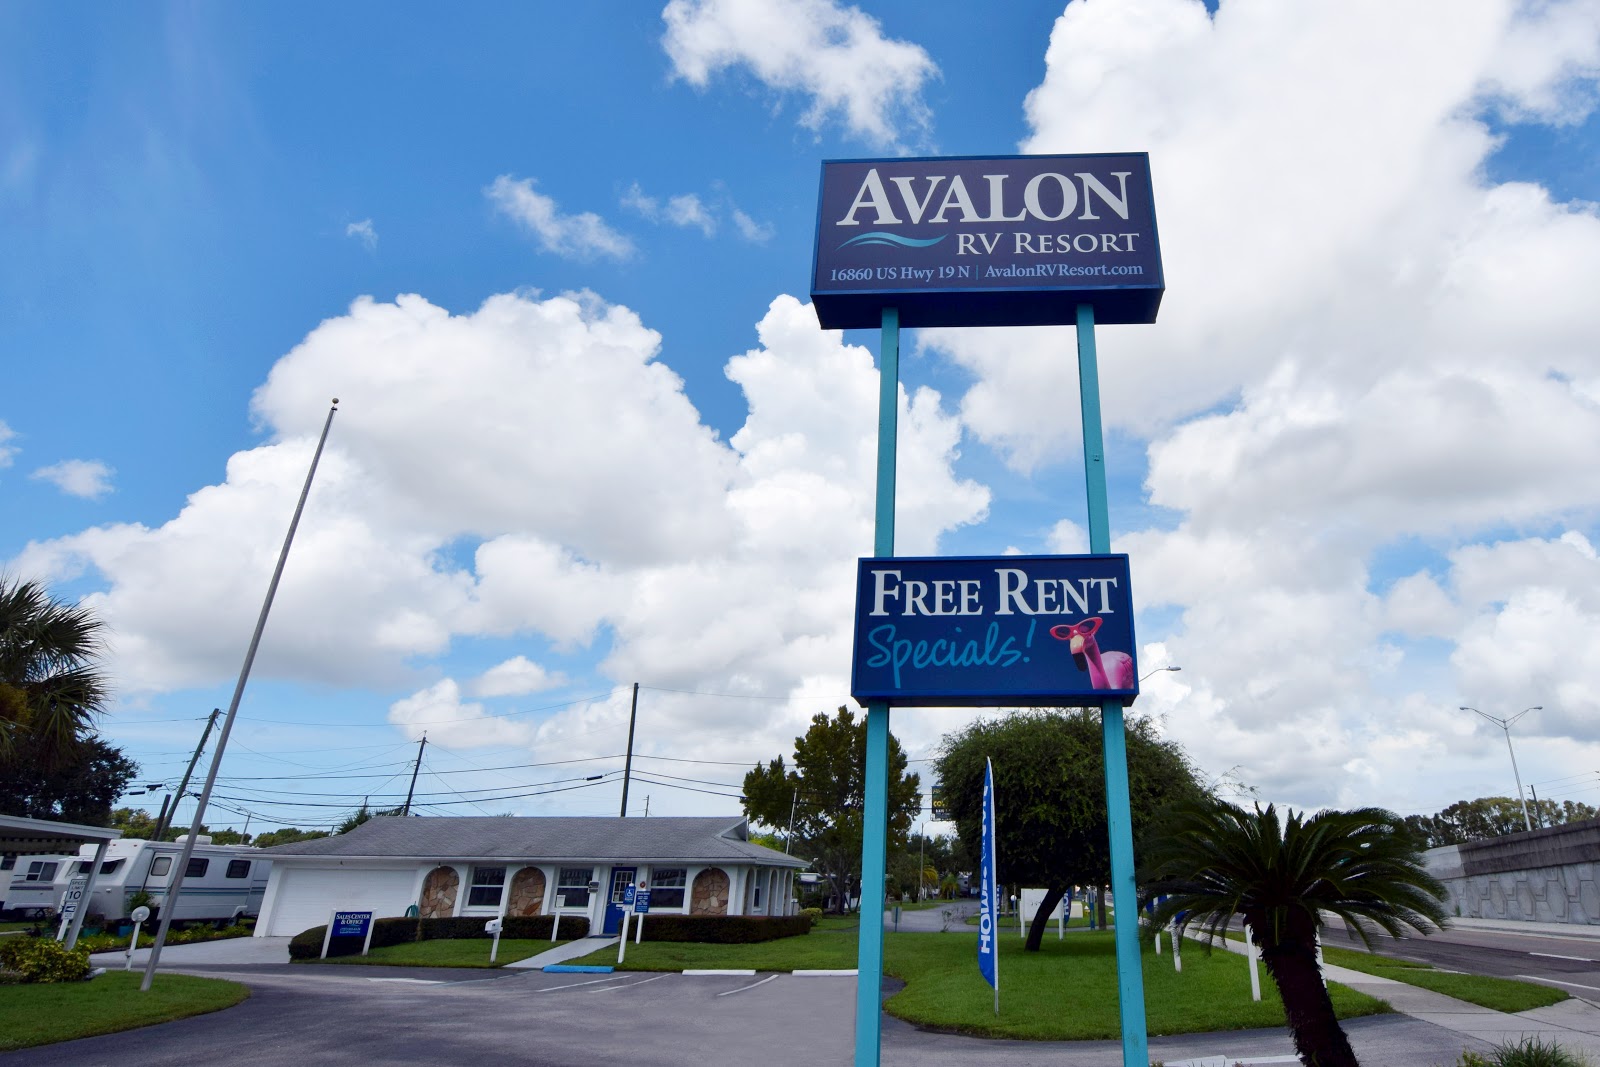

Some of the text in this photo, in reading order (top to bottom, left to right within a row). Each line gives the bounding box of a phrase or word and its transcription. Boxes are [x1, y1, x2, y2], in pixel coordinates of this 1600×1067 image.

[836, 168, 1132, 226] AVALON
[956, 232, 1140, 255] RV RESORT
[830, 263, 1144, 282] 16860 US Hwy 19 N AvalonRVResort.com
[869, 568, 1118, 616] FREE RENT
[866, 618, 1037, 689] Specials!
[69, 891, 81, 899] 10
